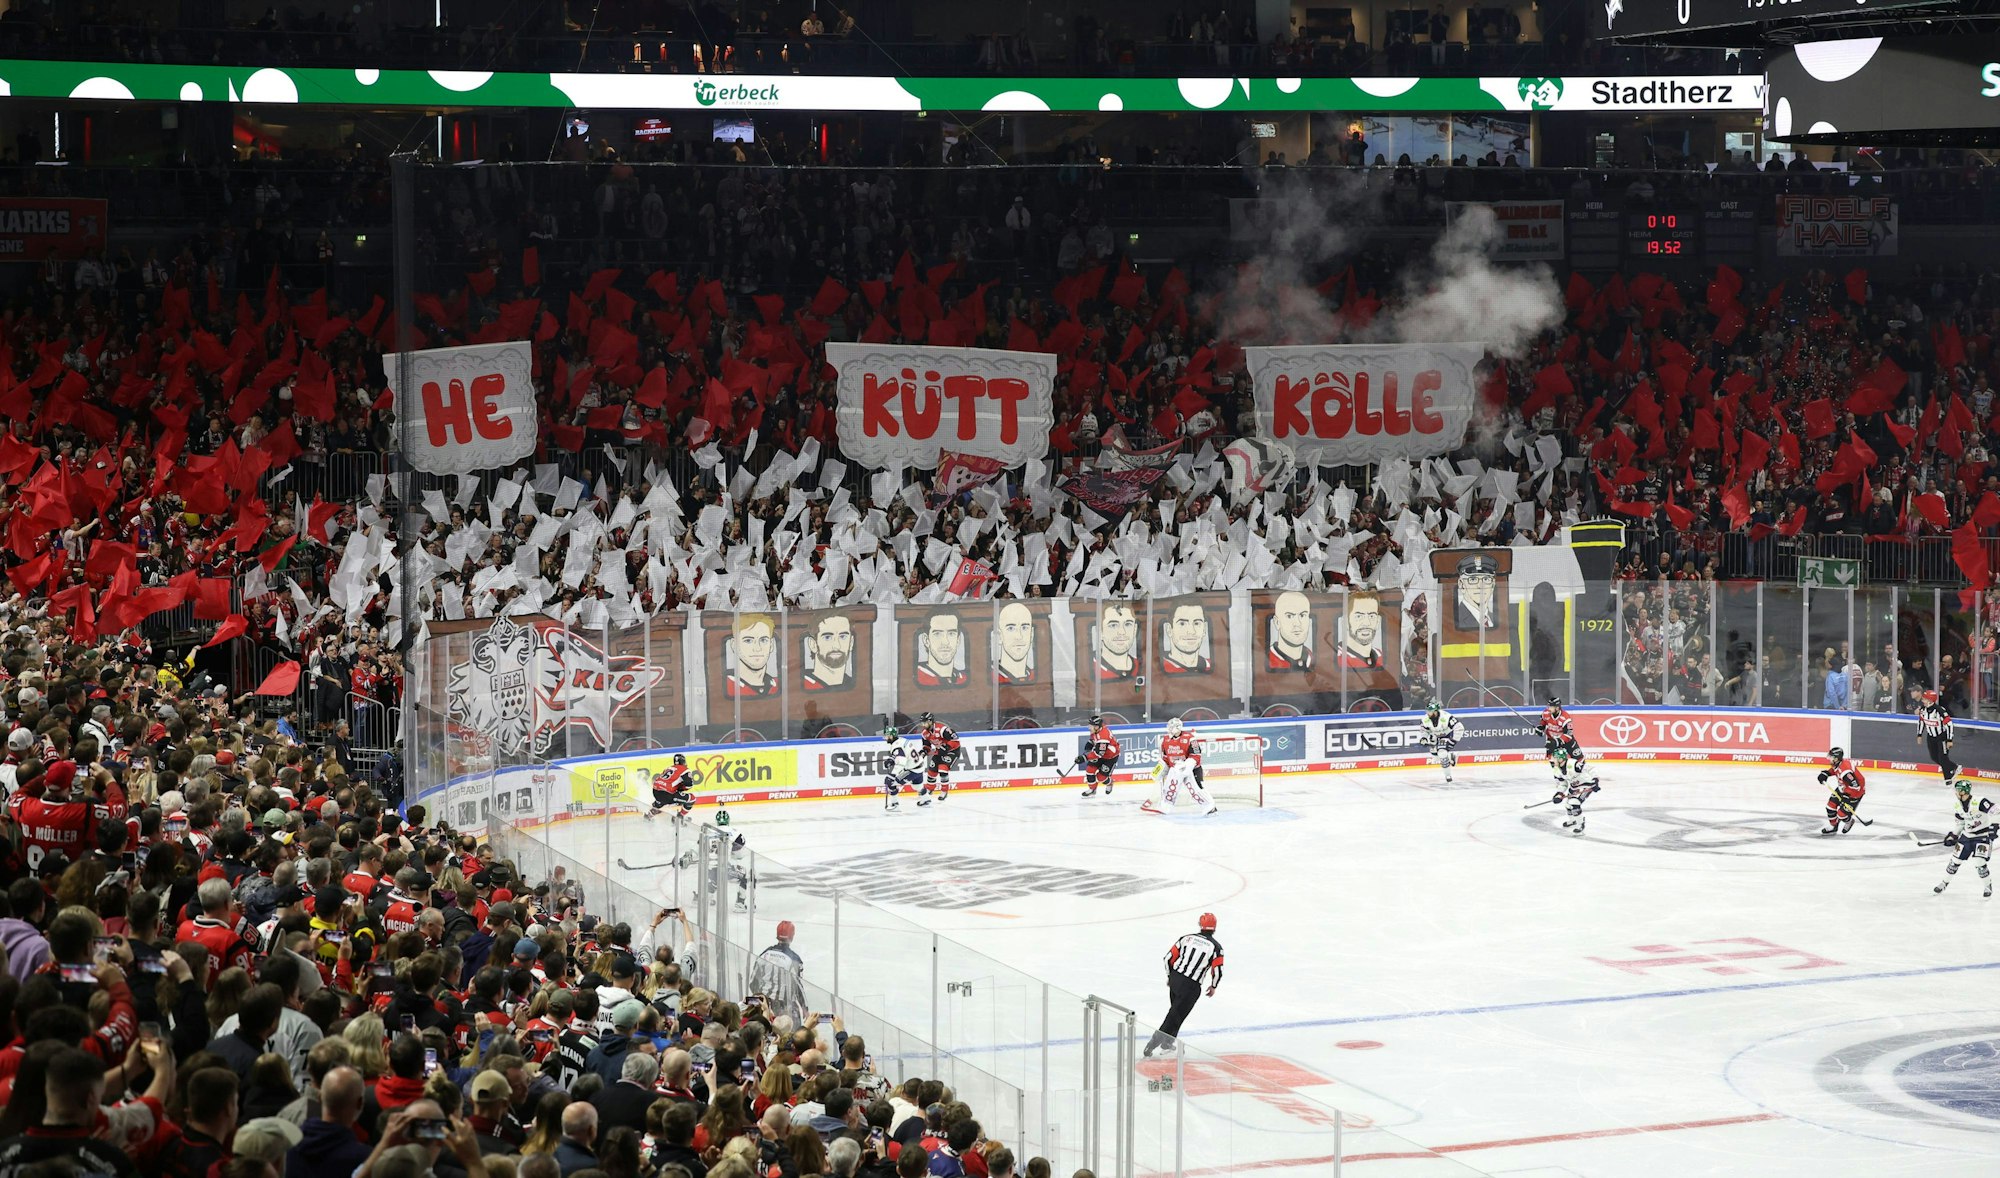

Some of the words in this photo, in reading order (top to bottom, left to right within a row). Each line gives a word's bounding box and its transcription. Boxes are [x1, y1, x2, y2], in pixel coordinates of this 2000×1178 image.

[1591, 80, 1733, 105] Stadtherz
[1585, 202, 1603, 210] HEIM
[1720, 201, 1738, 209] GAST
[1784, 197, 1889, 221] FIDELE
[1795, 223, 1869, 246] HAIE
[863, 368, 1029, 445] KÜTT
[1273, 370, 1444, 439] KÖLLE
[422, 373, 513, 447] HE
[1580, 619, 1613, 631] 1972
[1653, 720, 1770, 744] TOYOTA
[1627, 752, 1656, 760] PENNY.
[1680, 753, 1709, 761] PENNY.
[1732, 754, 1762, 762] PENNY.
[1784, 756, 1814, 764] PENNY.
[1330, 762, 1357, 770] PENNY.
[1378, 759, 1406, 767] PENNY.
[1891, 762, 1917, 771] PENNY.
[716, 757, 772, 783] Köln
[1281, 764, 1309, 772] PENNY.
[600, 773, 621, 781] Radio
[1033, 777, 1062, 786] PENNY.
[981, 780, 1010, 788] PENNY.
[769, 791, 798, 800] PENNY.
[822, 788, 853, 797] PENNY.
[716, 794, 745, 802] PENNY.
[36, 824, 78, 843] MÜLLER
